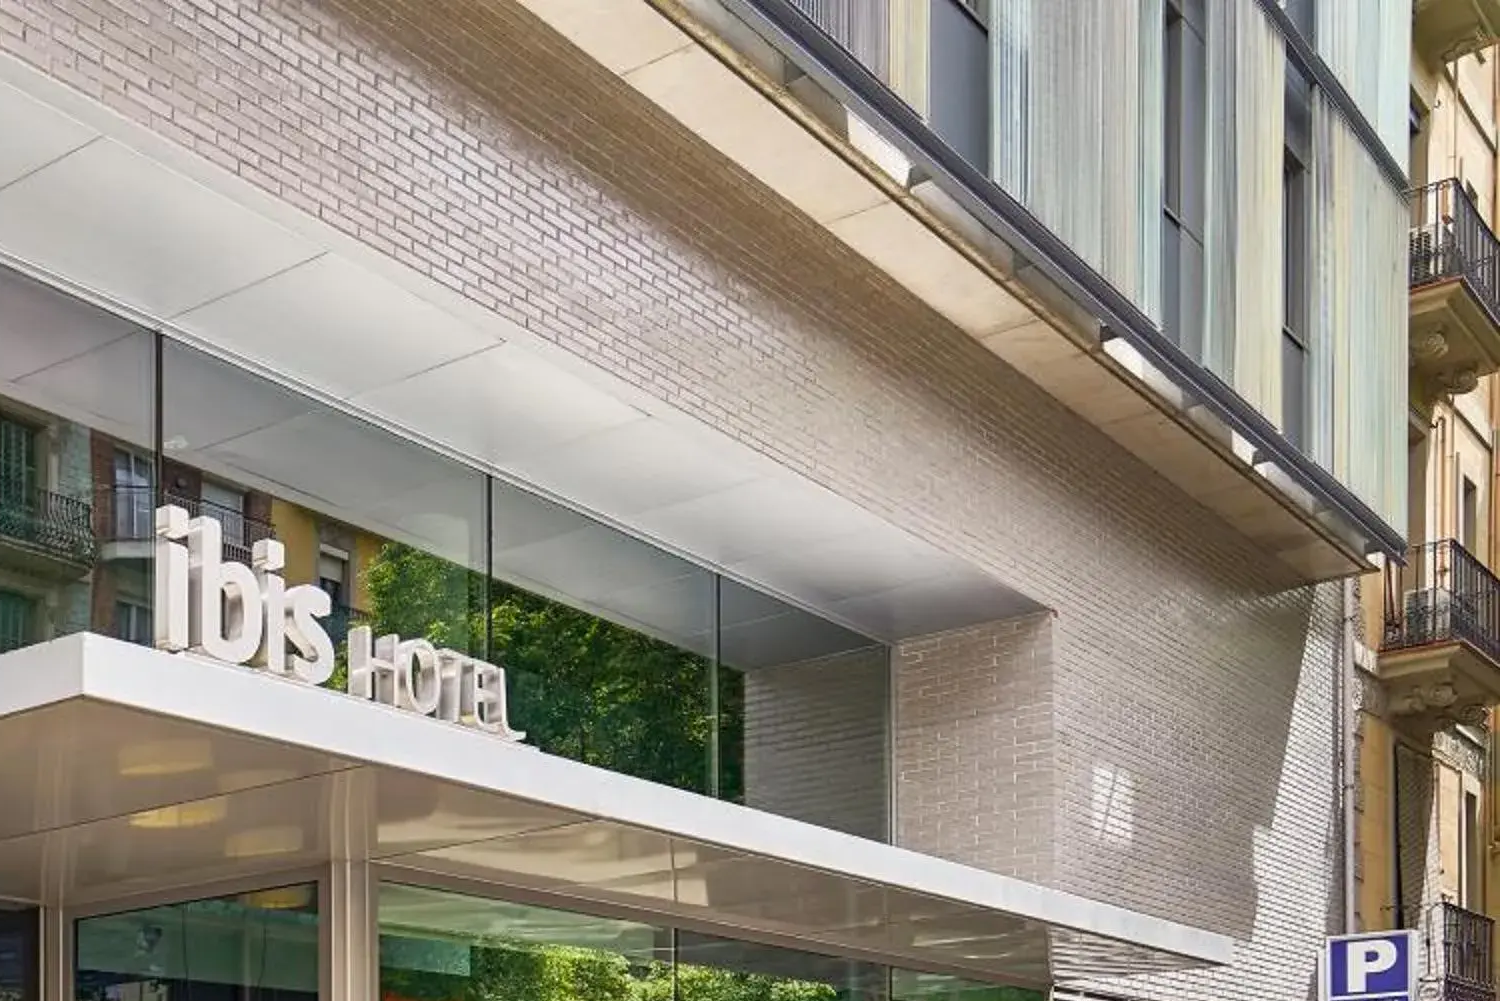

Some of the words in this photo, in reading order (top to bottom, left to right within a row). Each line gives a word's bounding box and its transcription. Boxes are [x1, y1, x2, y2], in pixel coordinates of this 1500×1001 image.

[155, 504, 335, 686] ibis
[348, 625, 526, 741] HOTEL
[1347, 940, 1398, 993] P
